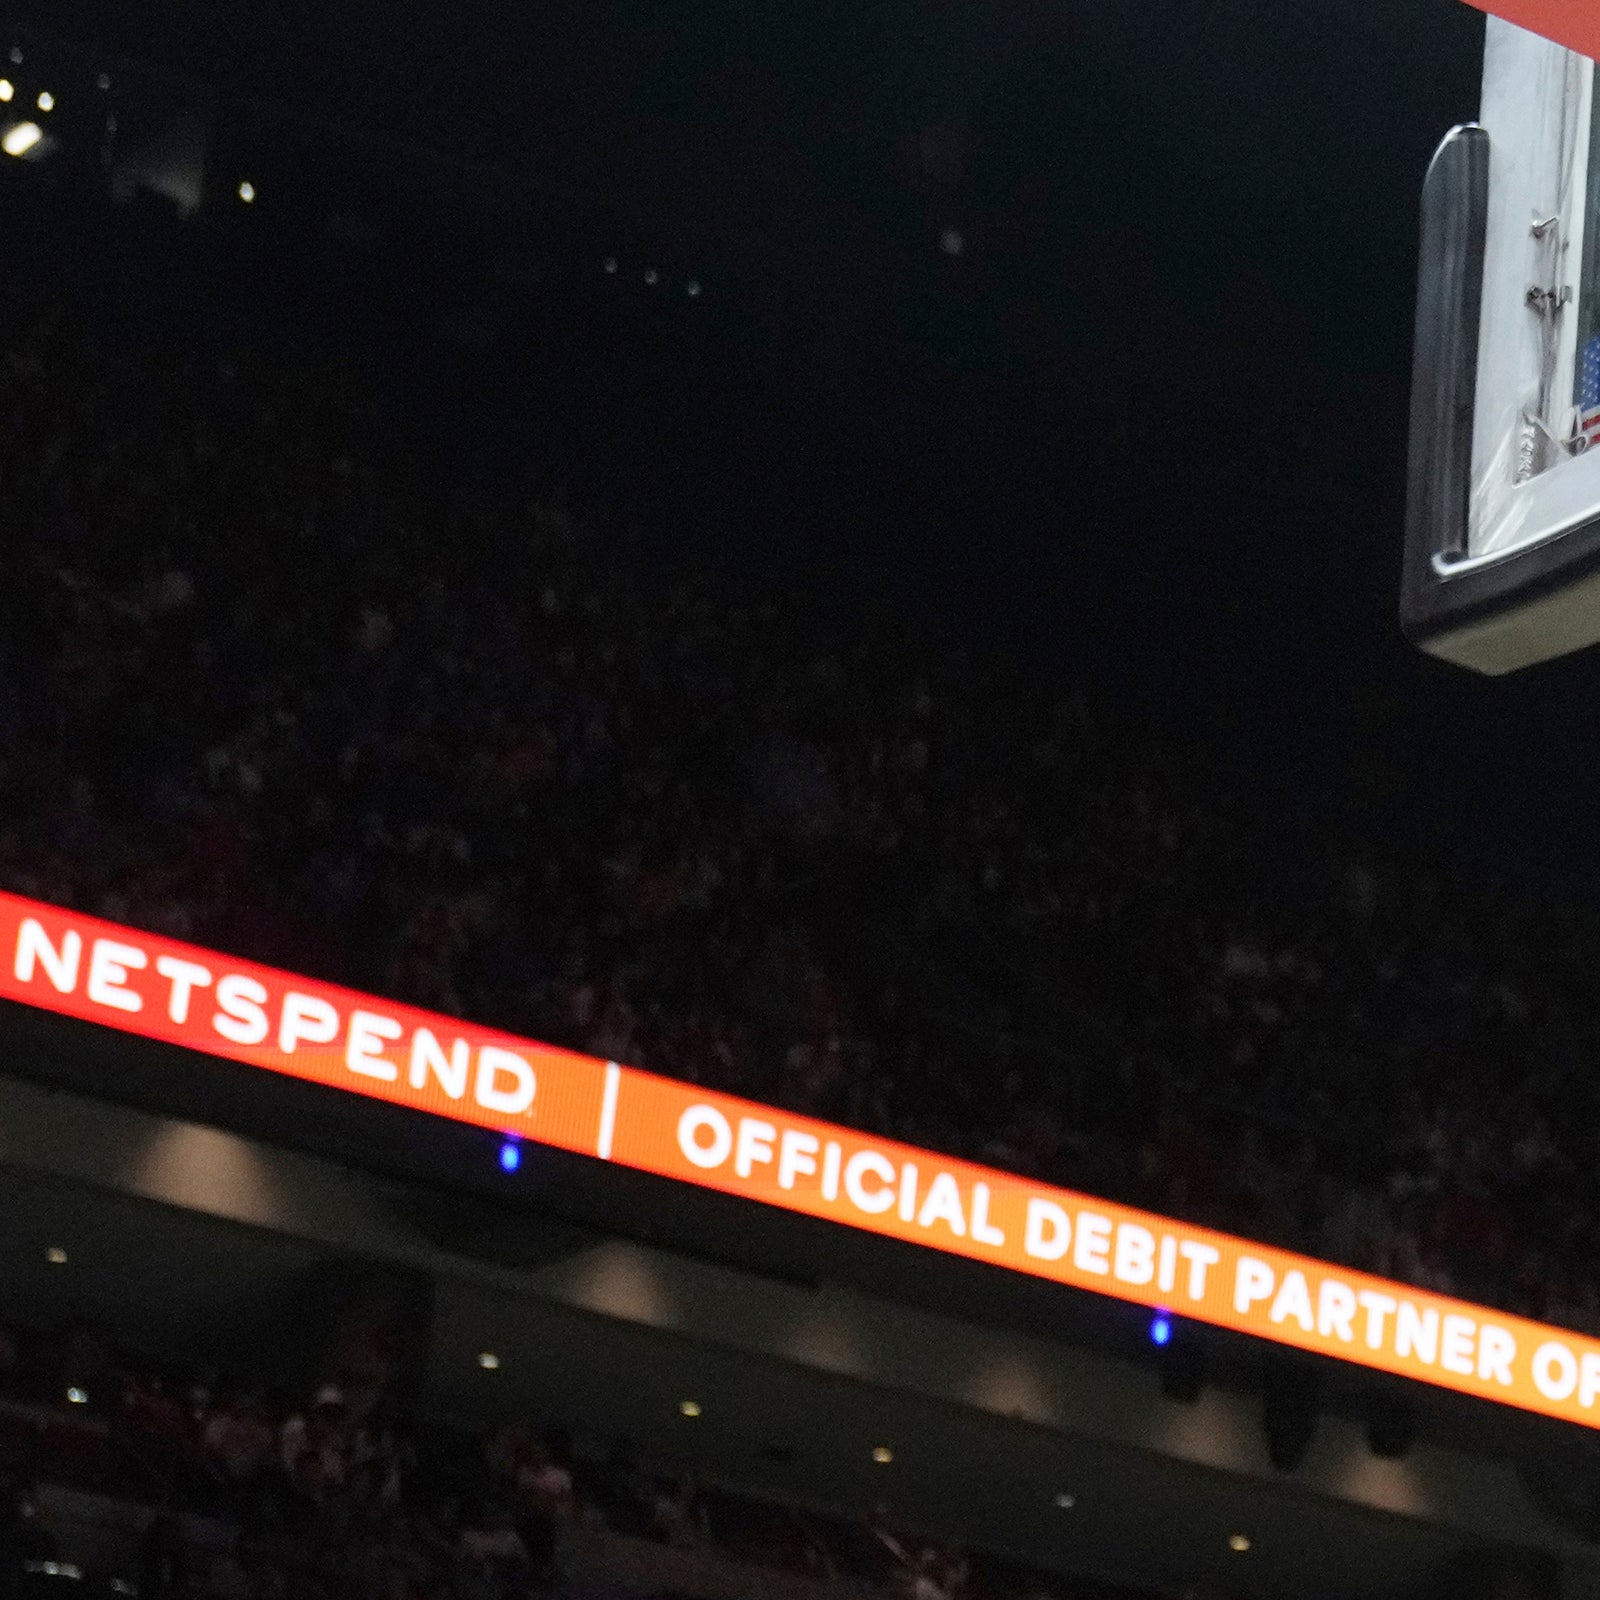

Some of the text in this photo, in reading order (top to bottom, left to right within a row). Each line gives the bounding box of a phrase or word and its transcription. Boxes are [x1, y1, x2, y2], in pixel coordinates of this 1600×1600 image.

[14, 917, 538, 1115] NETSPEND
[677, 1104, 1005, 1246] OFFICIAL
[1024, 1201, 1219, 1300] DEBIT
[1234, 1256, 1513, 1385] PARTNER
